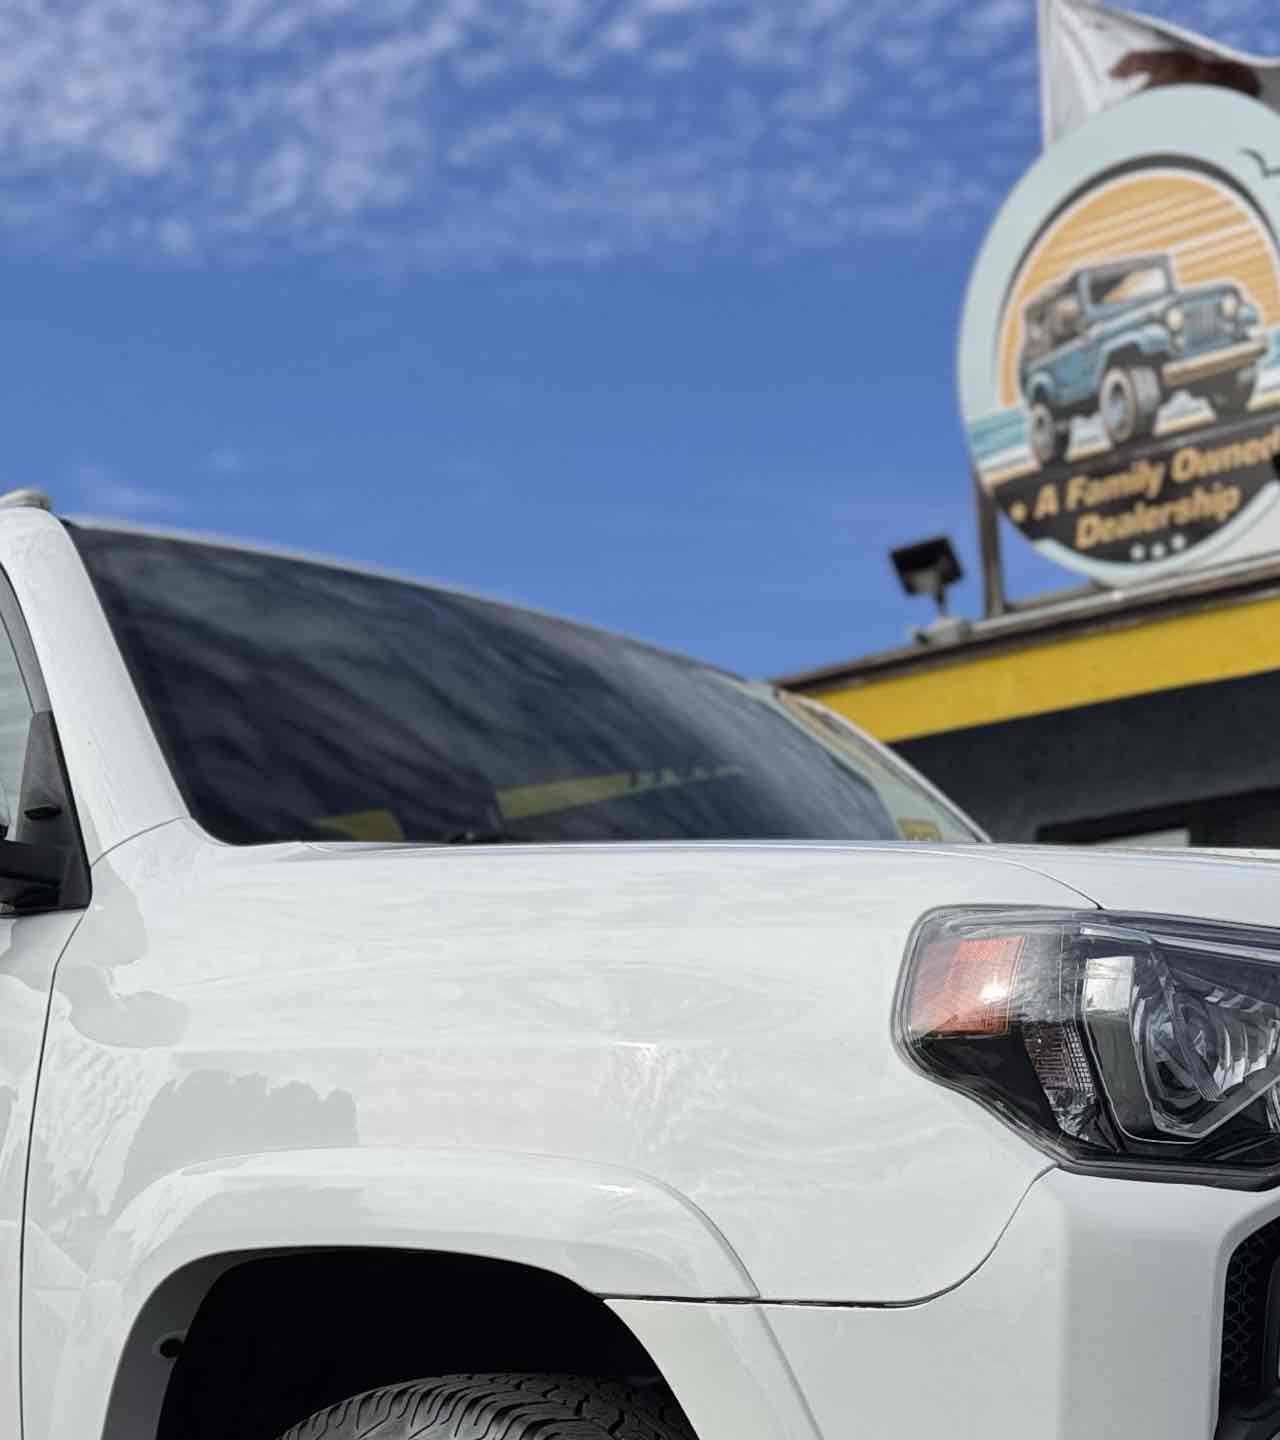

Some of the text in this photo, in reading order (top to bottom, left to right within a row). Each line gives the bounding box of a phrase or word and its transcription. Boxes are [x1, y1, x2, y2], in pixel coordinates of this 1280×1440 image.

[1033, 484, 1059, 520] A
[1065, 460, 1166, 511] Family
[1074, 485, 1242, 549] Dealership
